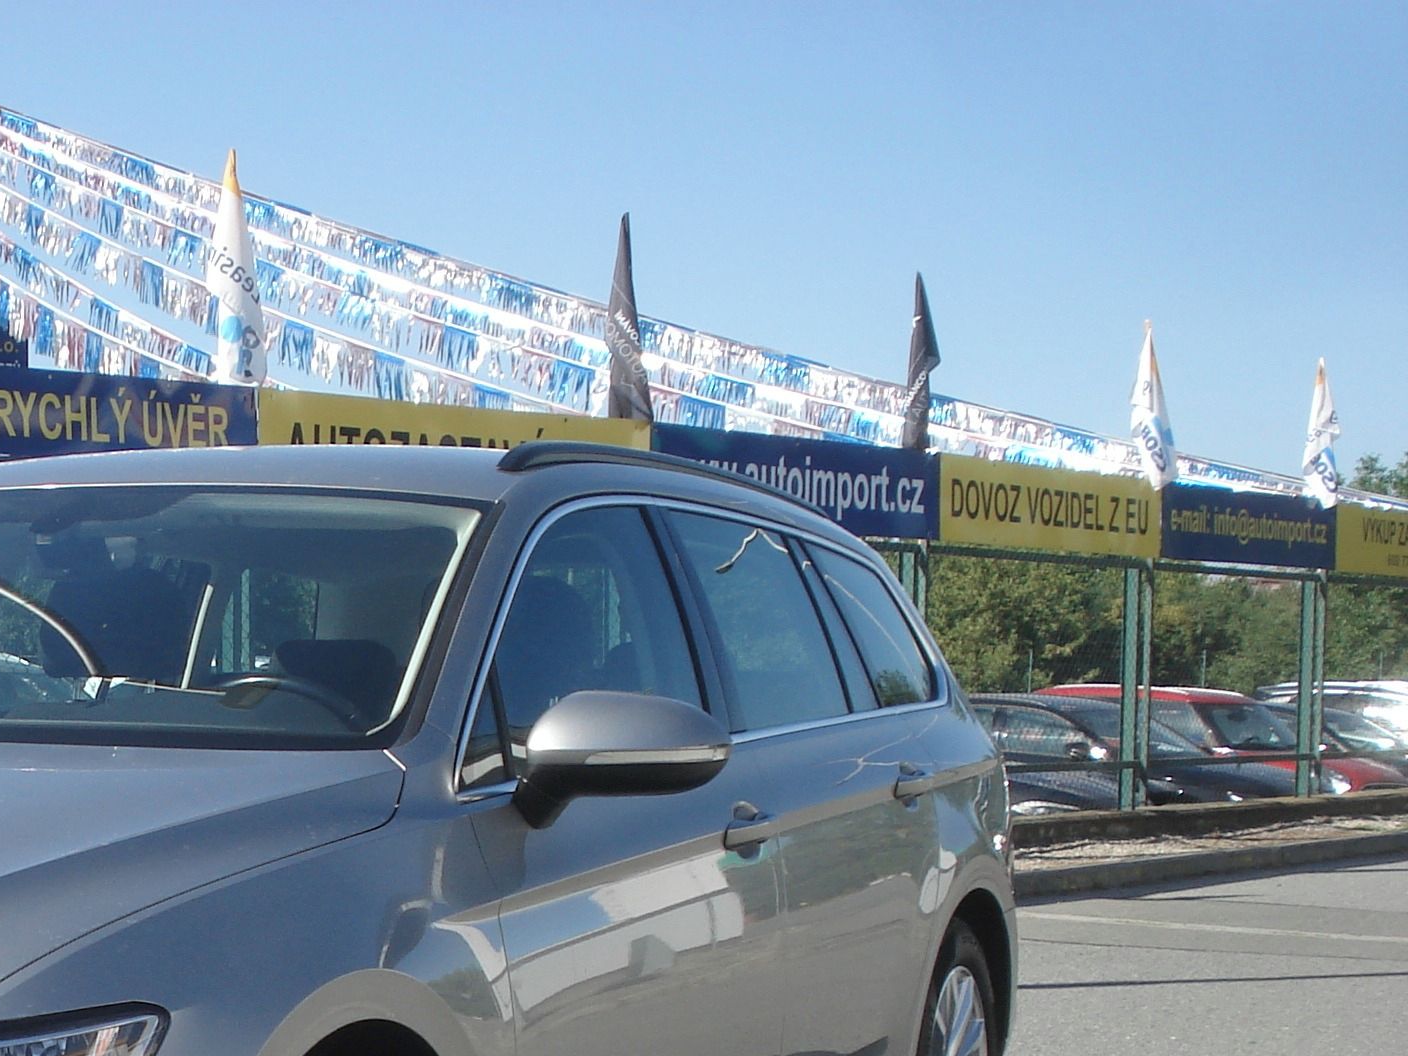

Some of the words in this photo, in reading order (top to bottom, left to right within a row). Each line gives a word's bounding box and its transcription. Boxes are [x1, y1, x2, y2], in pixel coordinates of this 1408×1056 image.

[142, 389, 230, 448] ÚVĚR
[700, 455, 925, 521] autoimport.cz
[951, 478, 1021, 523] DOVOZ
[1028, 486, 1104, 531] VOZIDEL
[1109, 496, 1120, 533] Z
[1125, 498, 1149, 535] EU
[1170, 504, 1211, 534] e-mail:
[1213, 505, 1328, 550] info@autoimport.cz
